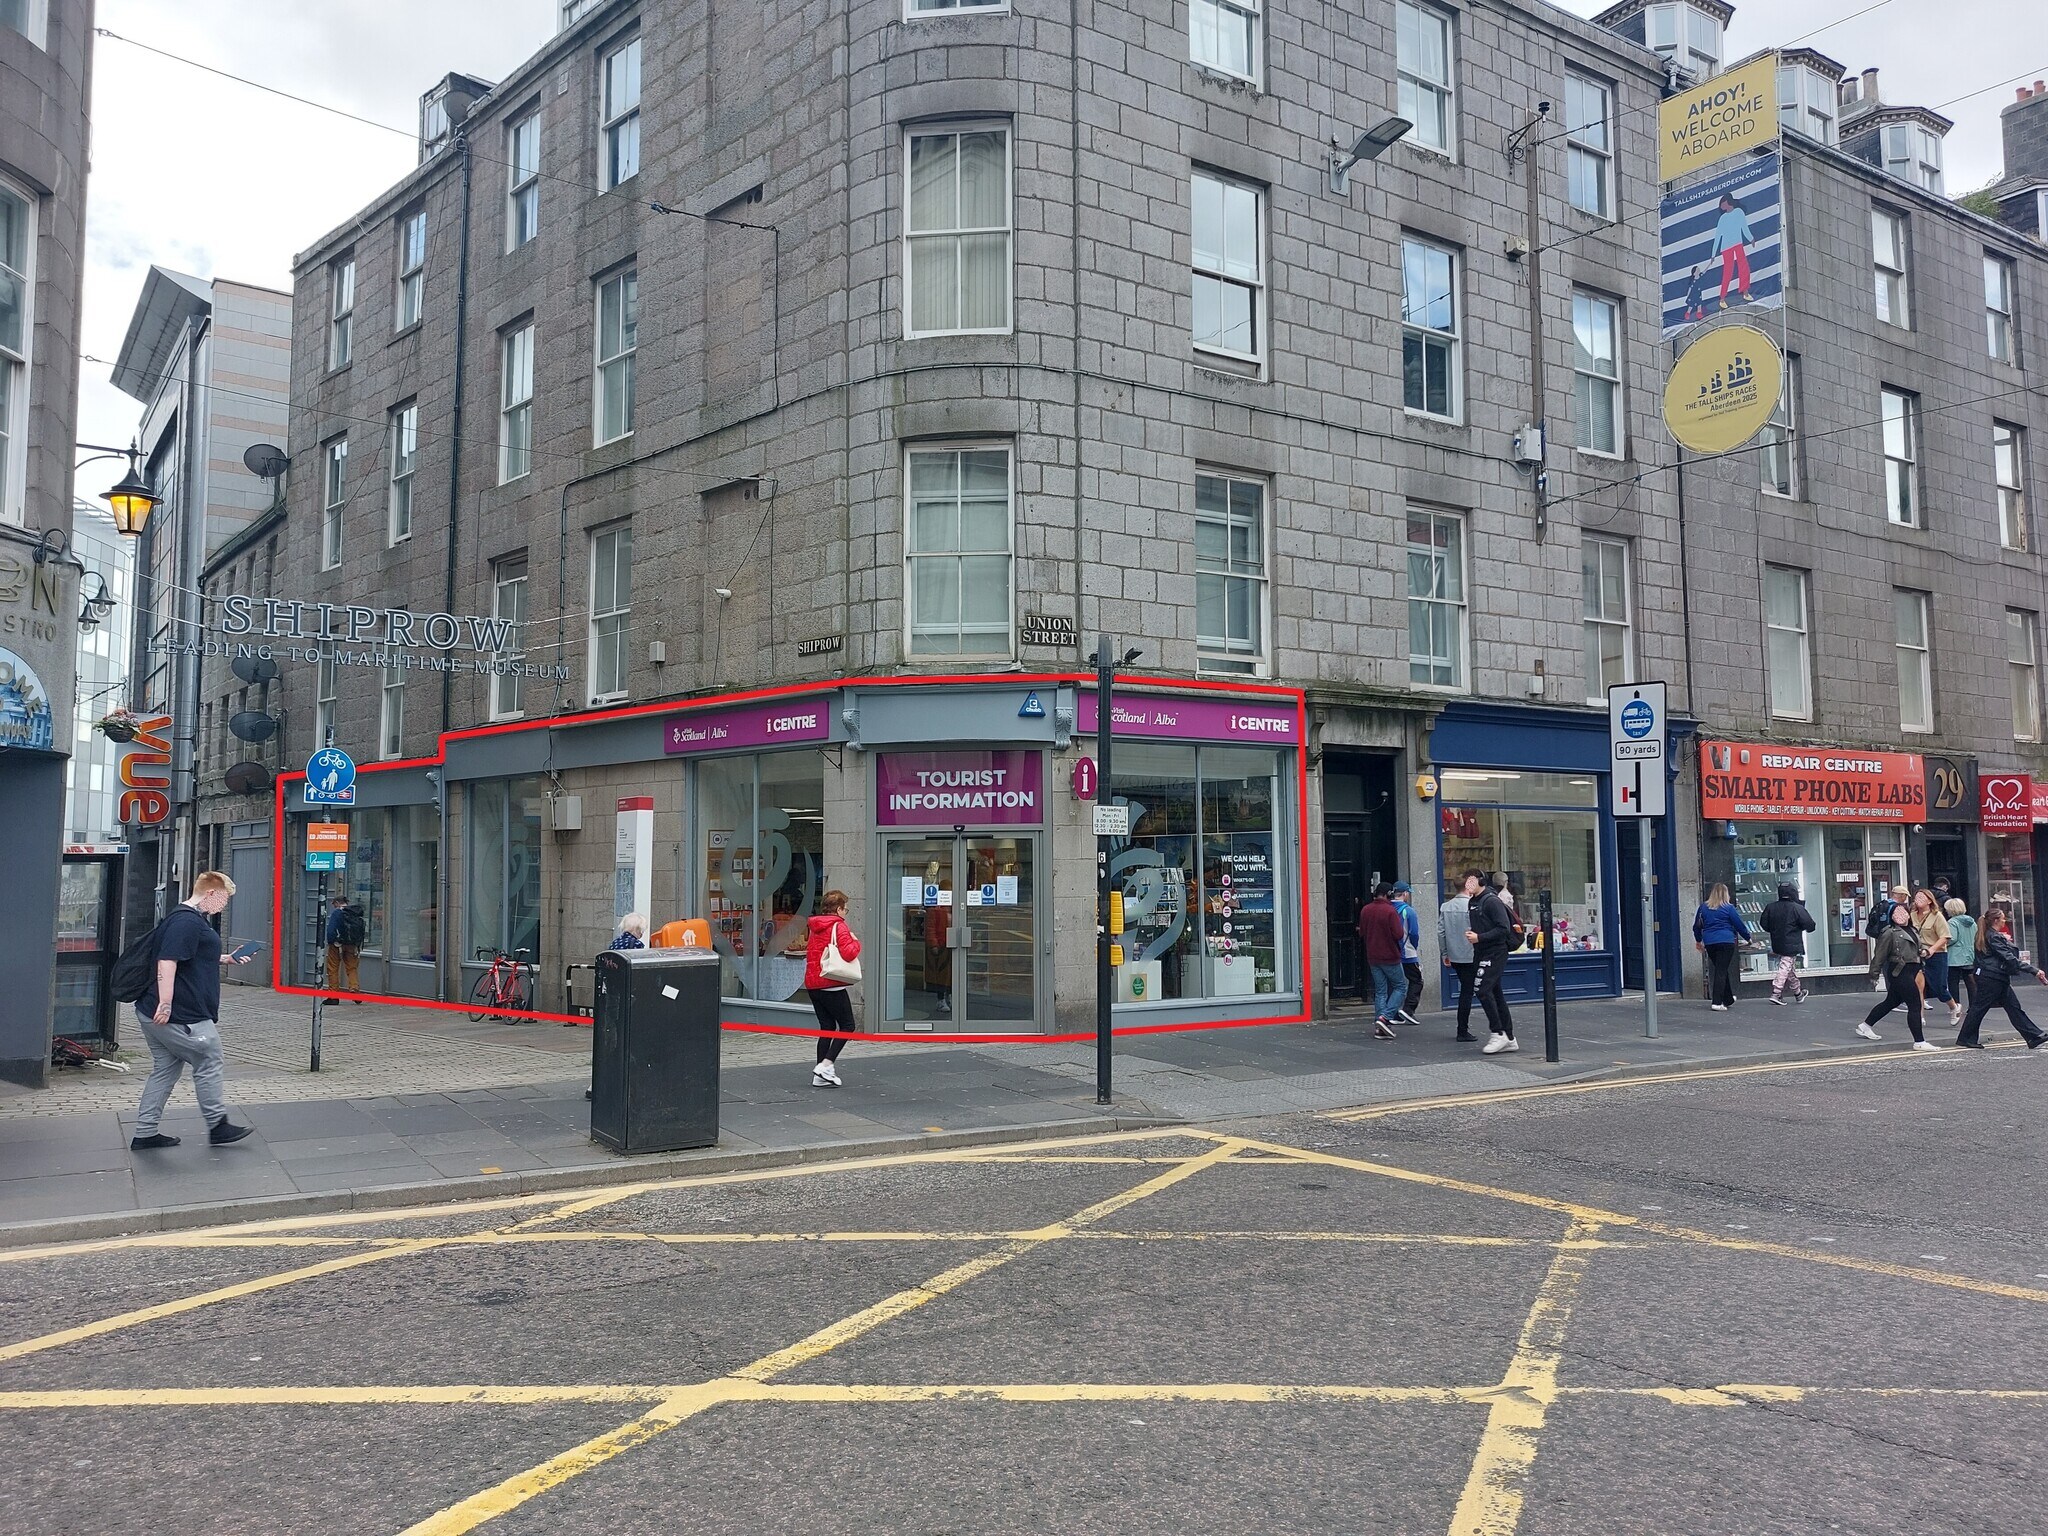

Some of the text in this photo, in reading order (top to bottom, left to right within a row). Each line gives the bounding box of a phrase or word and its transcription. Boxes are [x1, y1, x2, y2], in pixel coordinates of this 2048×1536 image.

[1688, 83, 1745, 119] AHOY!
[1672, 94, 1763, 143] WELCOME
[1680, 119, 1755, 160] ABOARD
[1674, 168, 1762, 208] TALLSHIPSABERDEEN.COM
[1685, 402, 1698, 411] THE
[1699, 399, 1713, 408] TALL
[1714, 391, 1734, 403] SHIPS
[1735, 384, 1757, 397] RACES
[1710, 399, 1741, 412] Aberdeen
[1742, 392, 1758, 403] 2025
[222, 594, 513, 654] SHIPROW
[1027, 616, 1072, 631] UNION
[798, 636, 841, 654] SHIPROW
[1022, 630, 1077, 645] STREET
[146, 637, 570, 680] LEADING TO MARITIME MUSEUM
[773, 714, 817, 732] CENTRE
[1111, 712, 1177, 726] cotland Alba
[1238, 716, 1290, 732] CENTRE
[681, 727, 728, 742] Scotland Alba
[1619, 745, 1656, 756] 90 yards
[1761, 754, 1883, 773] REPAIR CENTRE
[916, 769, 1007, 787] TOURIST
[1705, 774, 1924, 806] SMART PHONE LABS
[1934, 767, 1964, 809] 29
[889, 791, 1034, 810] INFORMATION
[1734, 804, 1750, 813] MOBILE
[1750, 804, 1764, 813] PHONE
[1767, 805, 1781, 814] TABLET
[1784, 805, 1790, 814] PC
[1790, 805, 1804, 814] REPAIR
[1807, 806, 1829, 815] UNLOCKING
[1832, 807, 1840, 815] KEY
[2032, 796, 2045, 806] eart
[1100, 852, 1104, 863] 6
